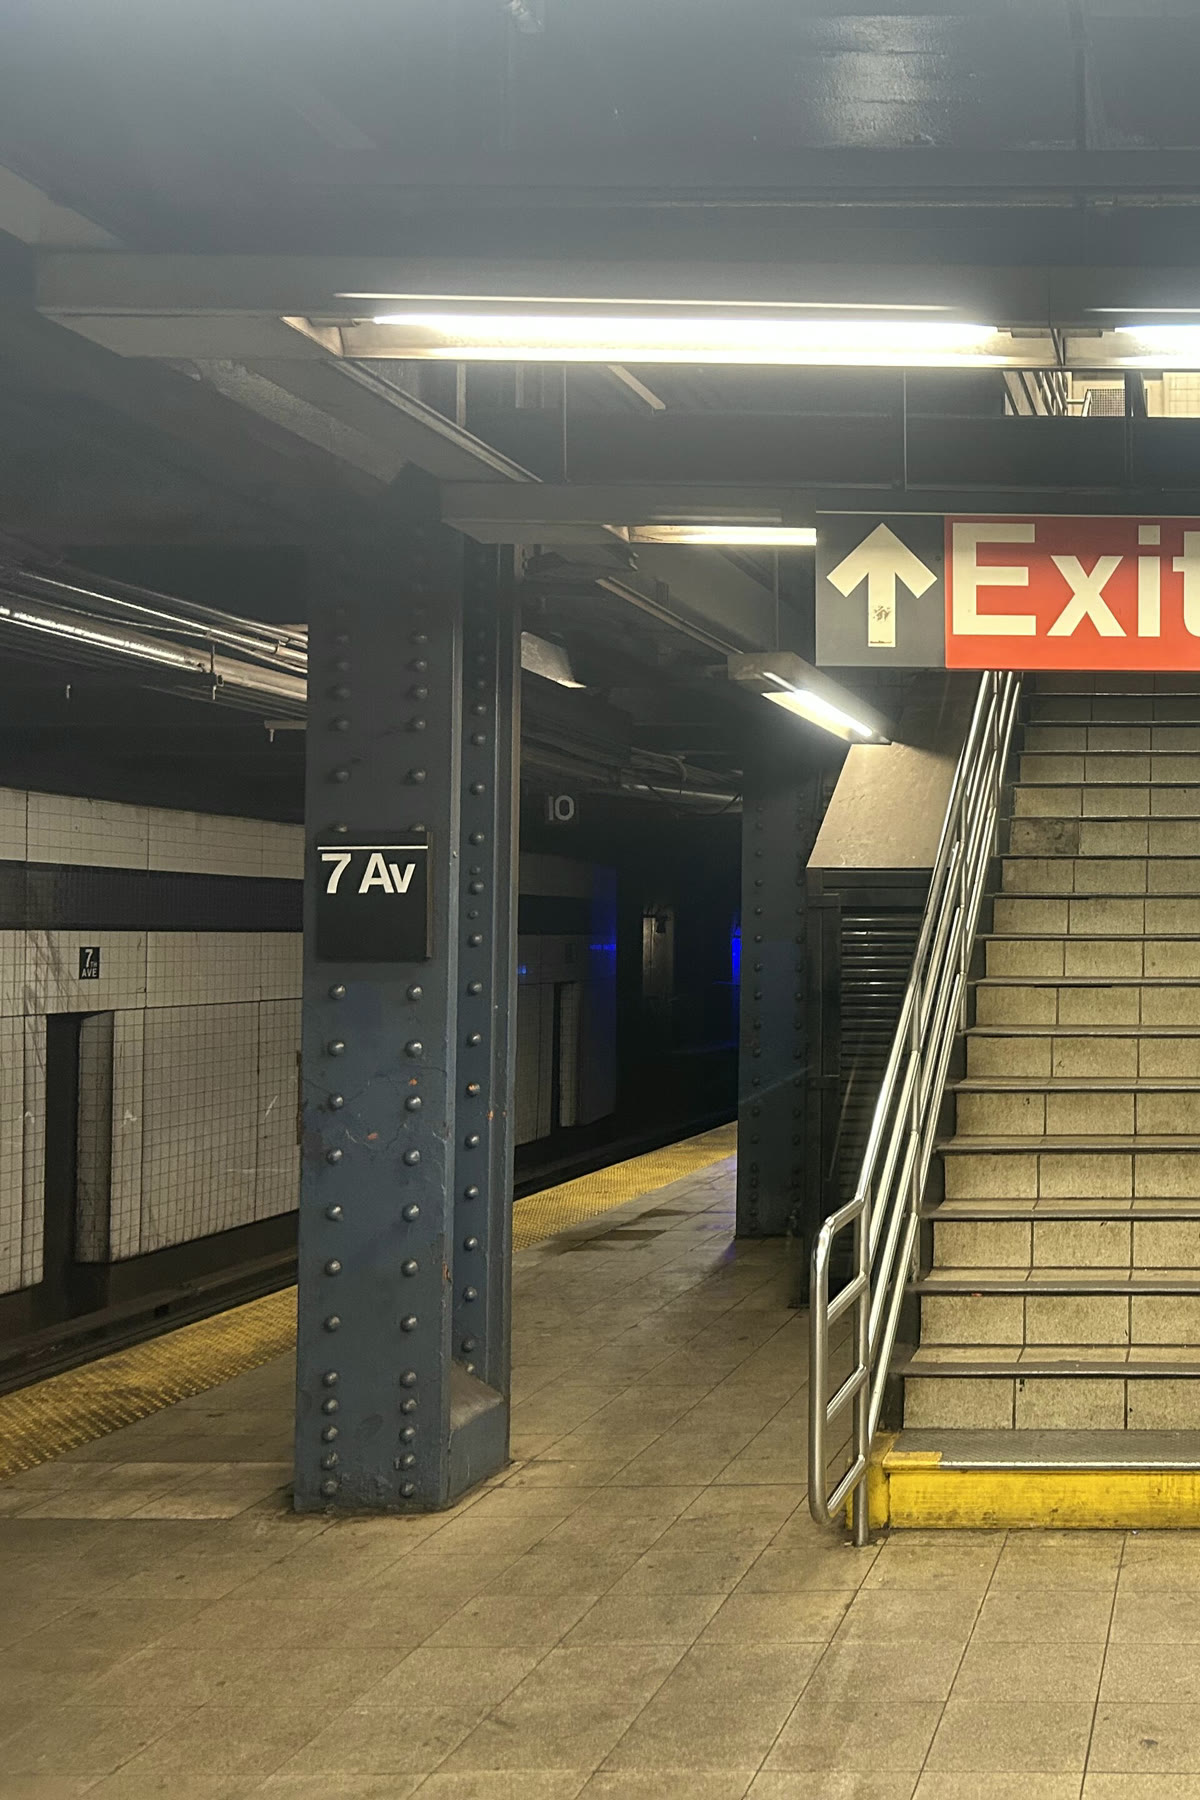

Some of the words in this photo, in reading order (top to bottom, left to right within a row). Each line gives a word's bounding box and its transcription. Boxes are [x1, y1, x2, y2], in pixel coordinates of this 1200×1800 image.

[548, 794, 575, 821] 10
[321, 853, 352, 894] 7
[358, 852, 416, 894] Av
[81, 968, 98, 978] AVE
